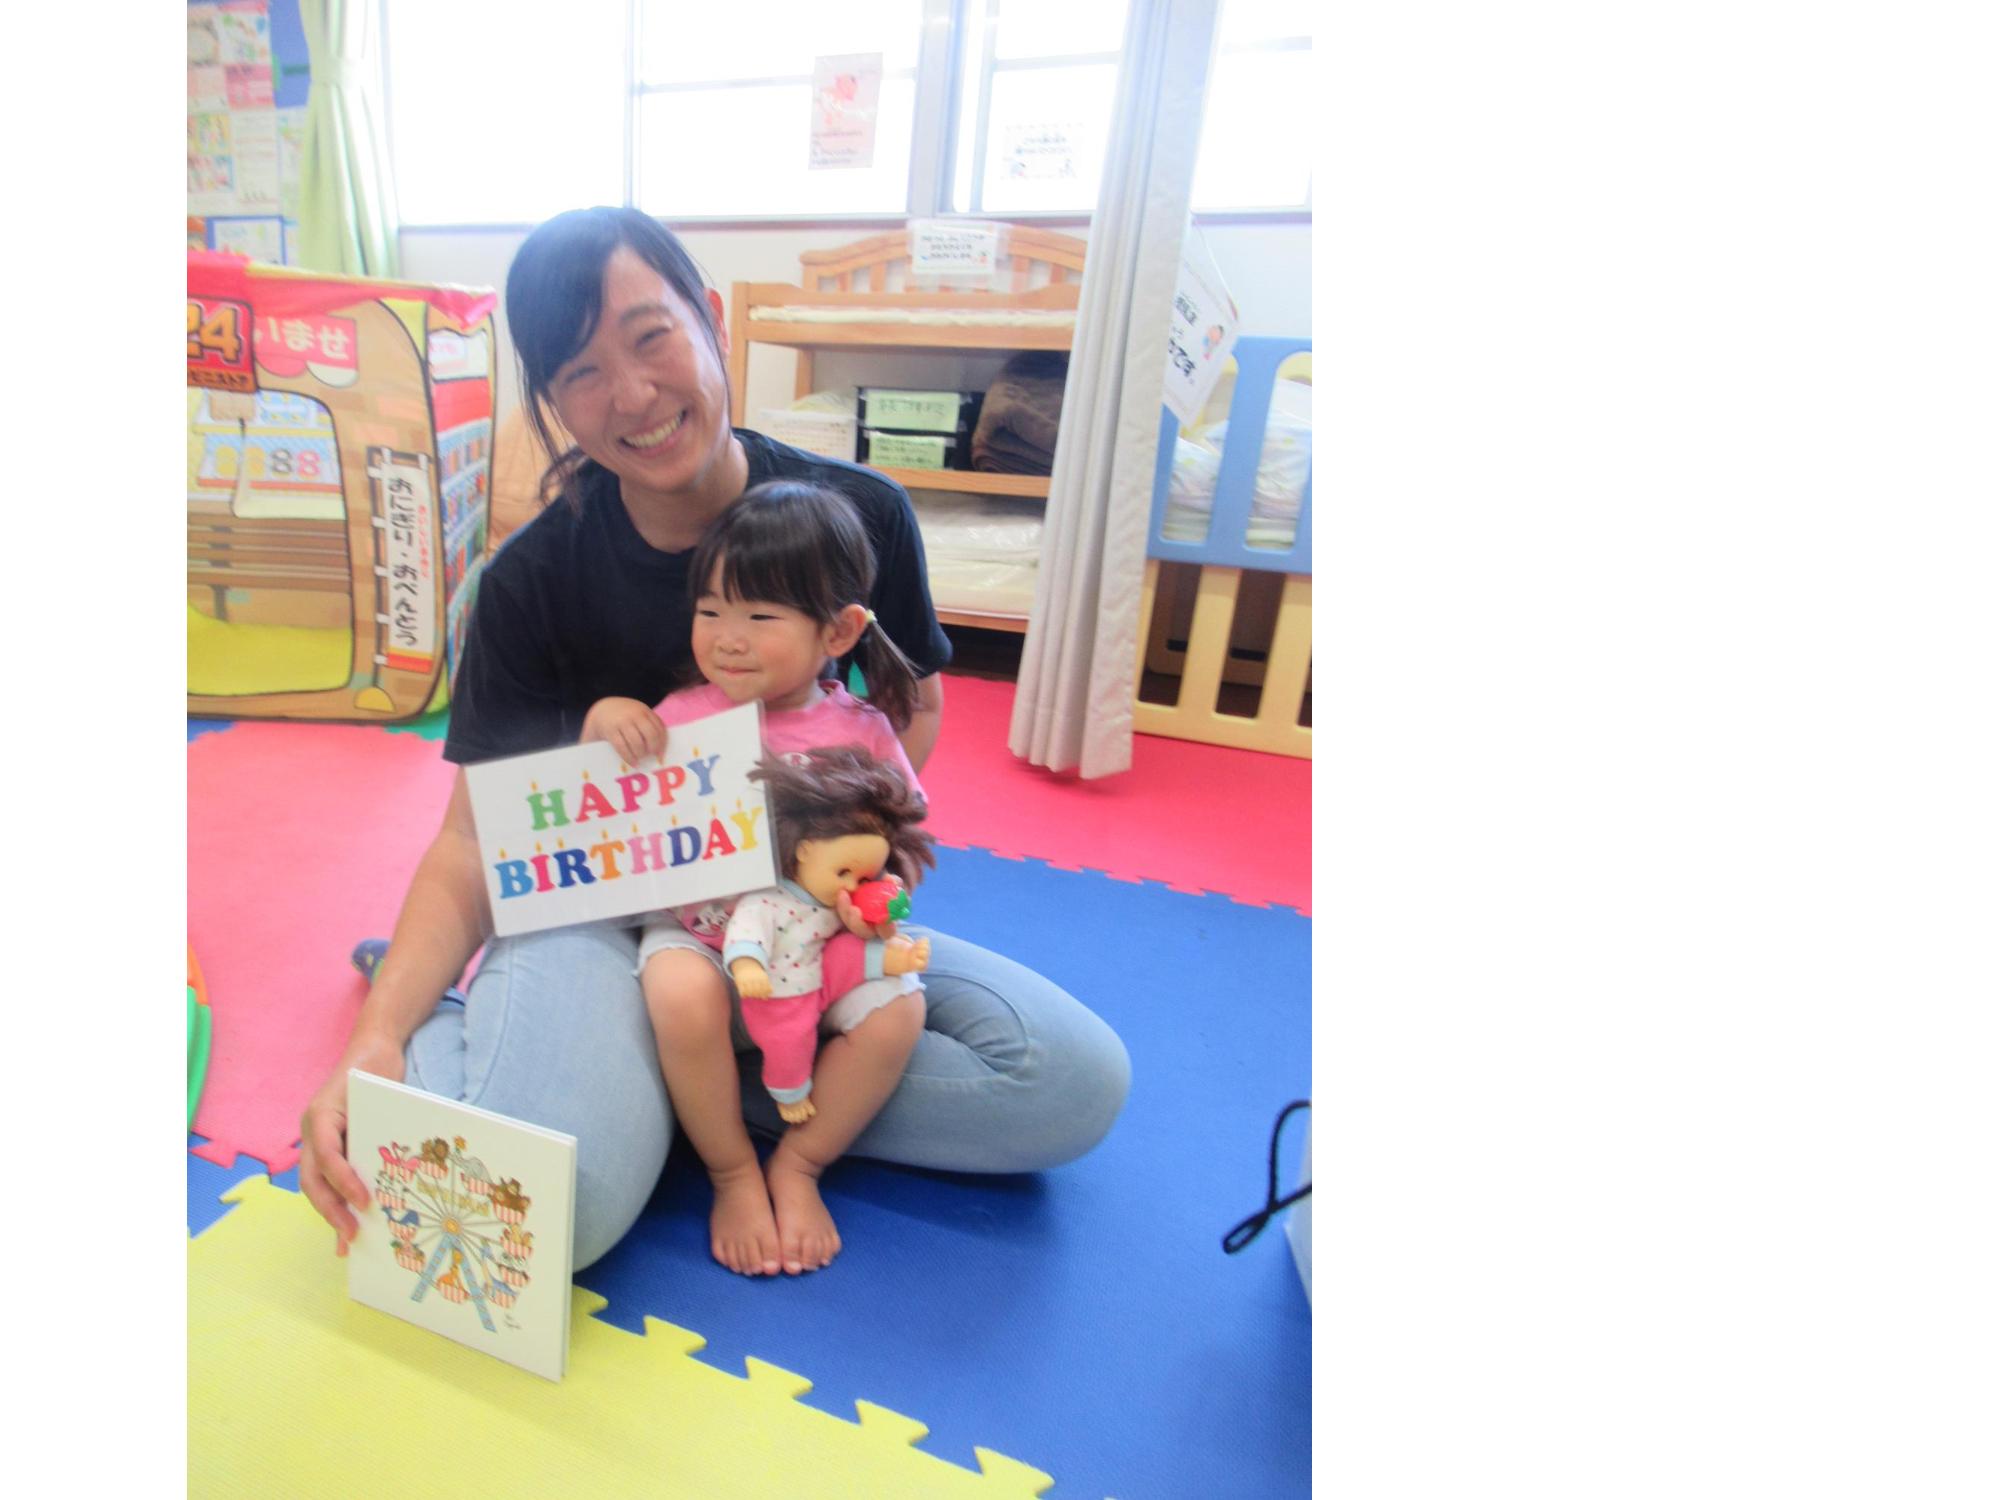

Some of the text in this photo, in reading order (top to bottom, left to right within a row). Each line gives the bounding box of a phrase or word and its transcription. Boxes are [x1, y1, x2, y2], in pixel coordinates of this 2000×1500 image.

[388, 477, 419, 646] おにぎり・おべんとう
[526, 754, 721, 831] HAPPY
[494, 806, 764, 899] BIRTHDAY
